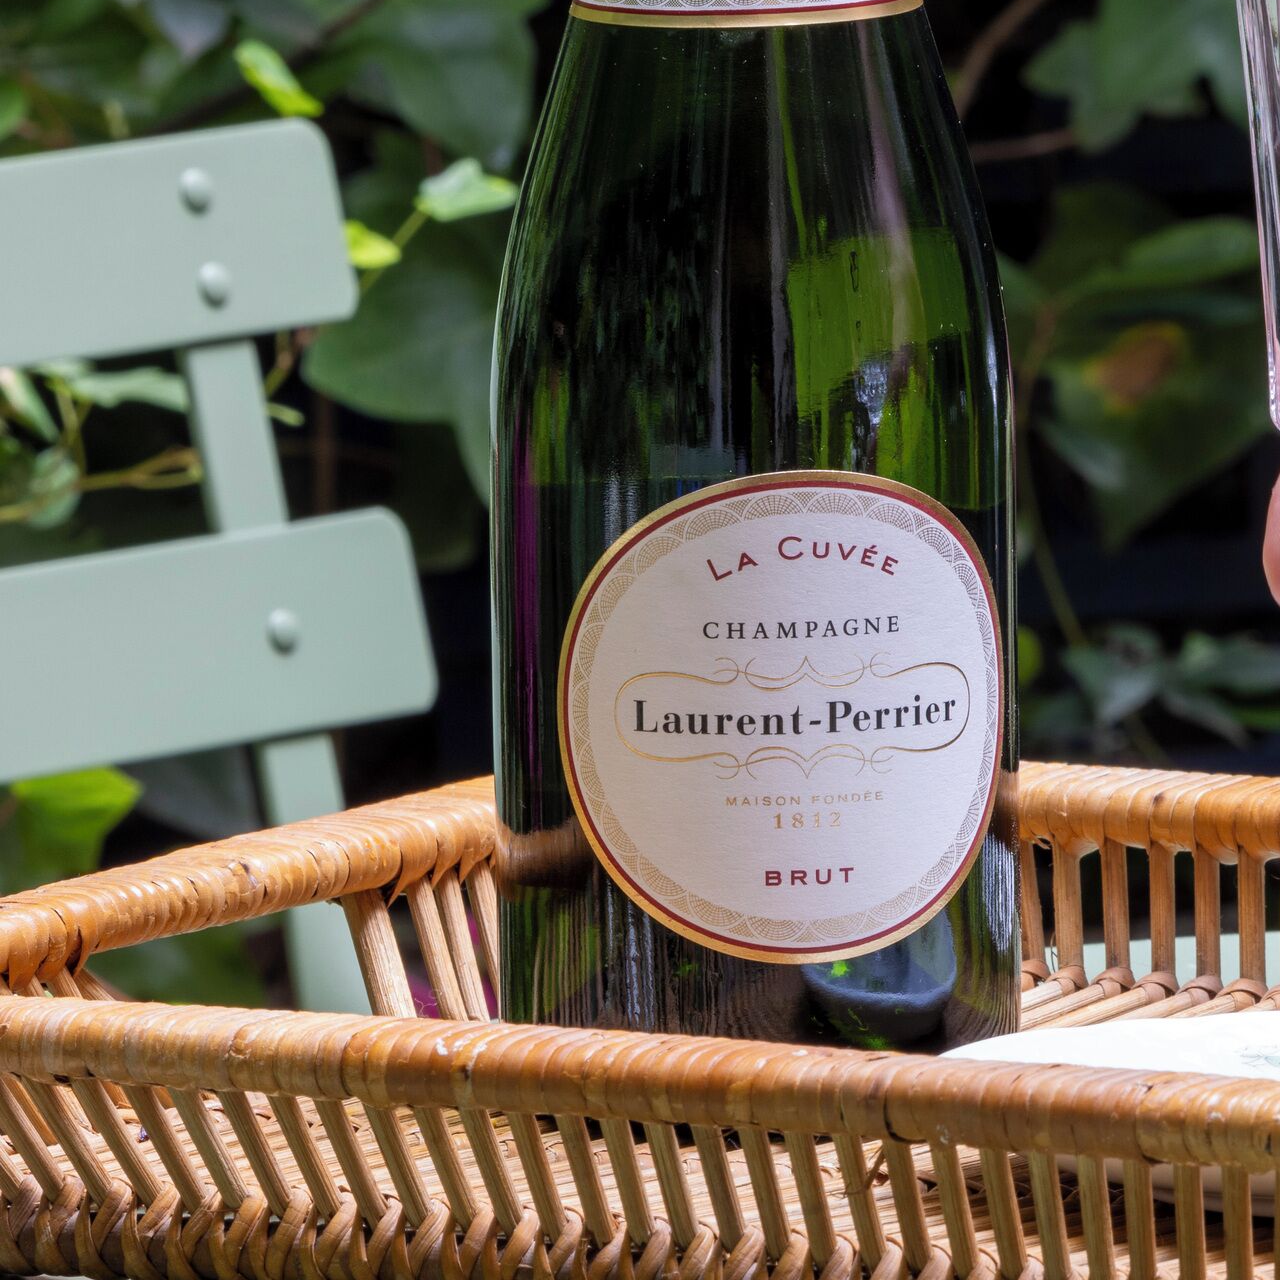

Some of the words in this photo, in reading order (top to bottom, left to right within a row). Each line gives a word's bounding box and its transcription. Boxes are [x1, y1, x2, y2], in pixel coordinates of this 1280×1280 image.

[703, 614, 901, 641] CHAMPAGNE
[633, 693, 957, 737] Laurent-Perrier
[725, 795, 802, 808] MAISON
[811, 790, 884, 805] FONDÉE
[774, 811, 842, 830] 1812
[764, 866, 855, 887] BRUT
